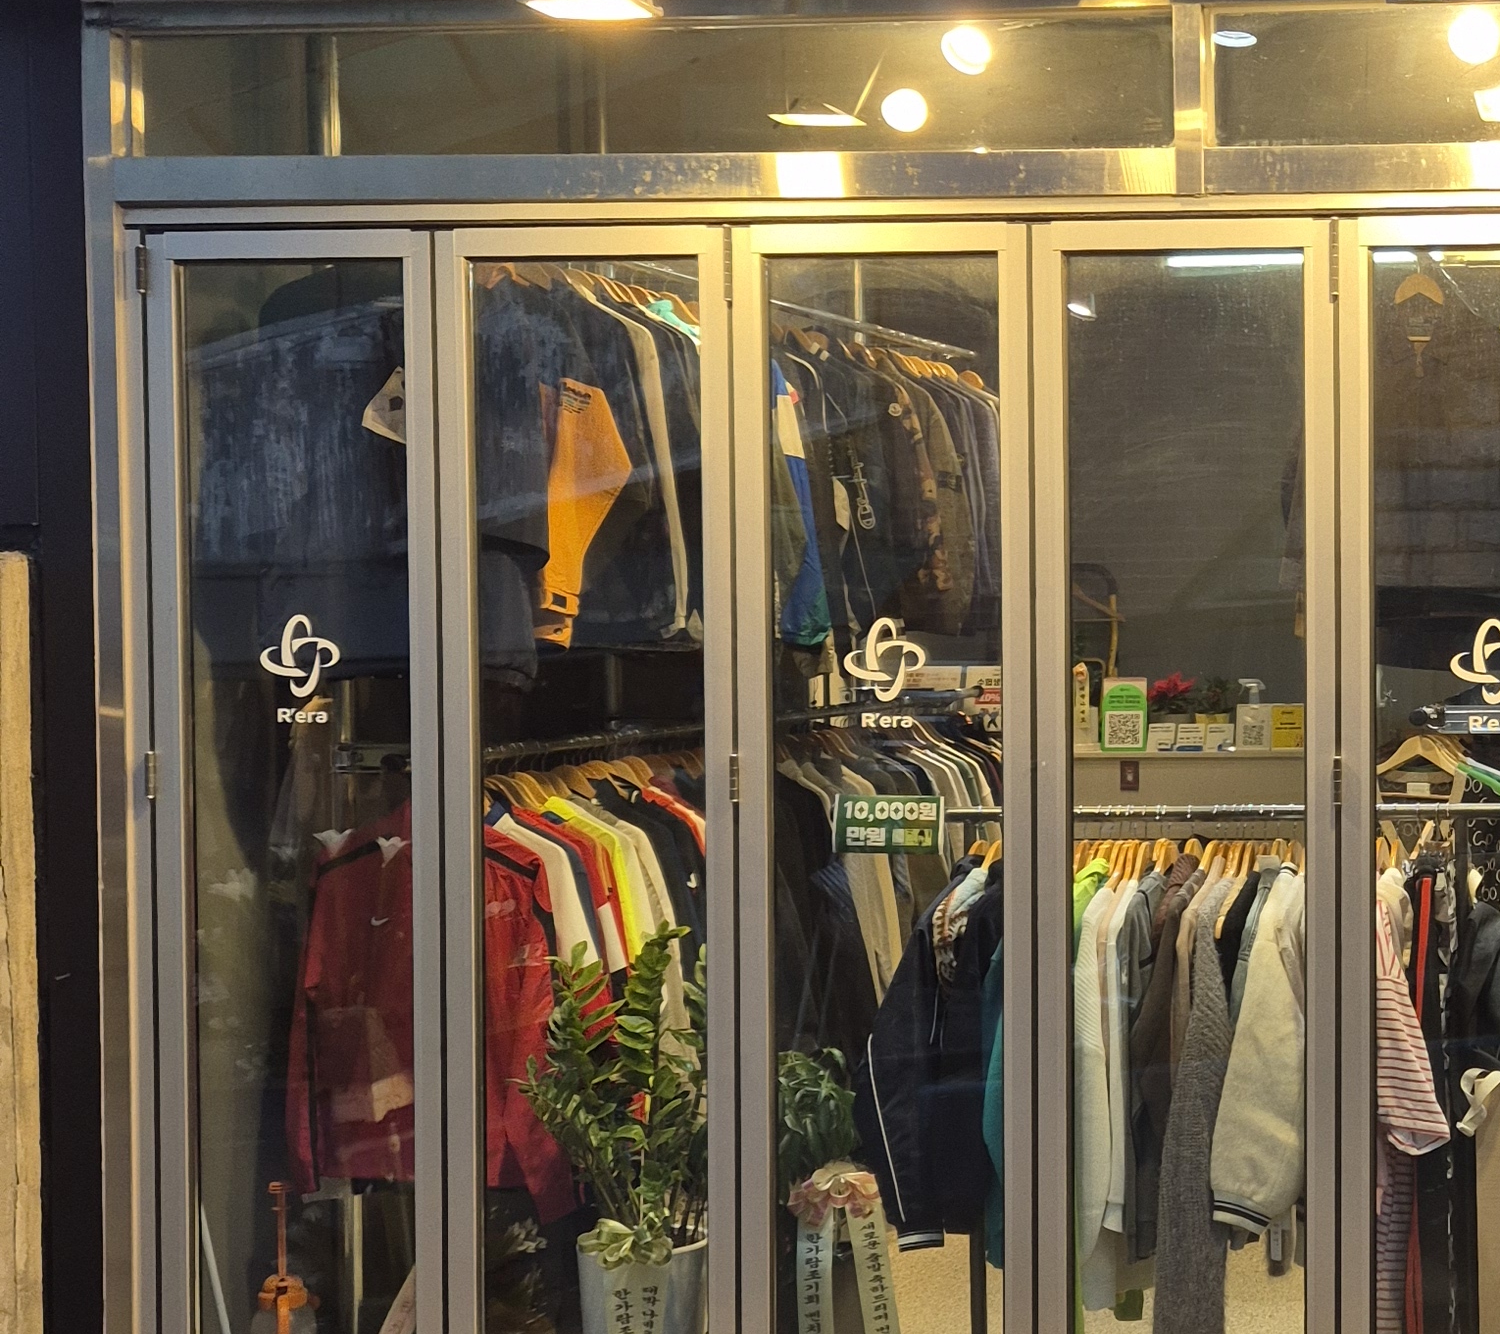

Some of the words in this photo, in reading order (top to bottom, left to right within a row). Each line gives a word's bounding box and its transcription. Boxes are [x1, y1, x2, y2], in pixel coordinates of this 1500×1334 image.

[277, 708, 328, 723] R'era
[861, 712, 914, 728] R'era
[843, 801, 937, 822] 10,000원
[846, 826, 886, 847] 만원
